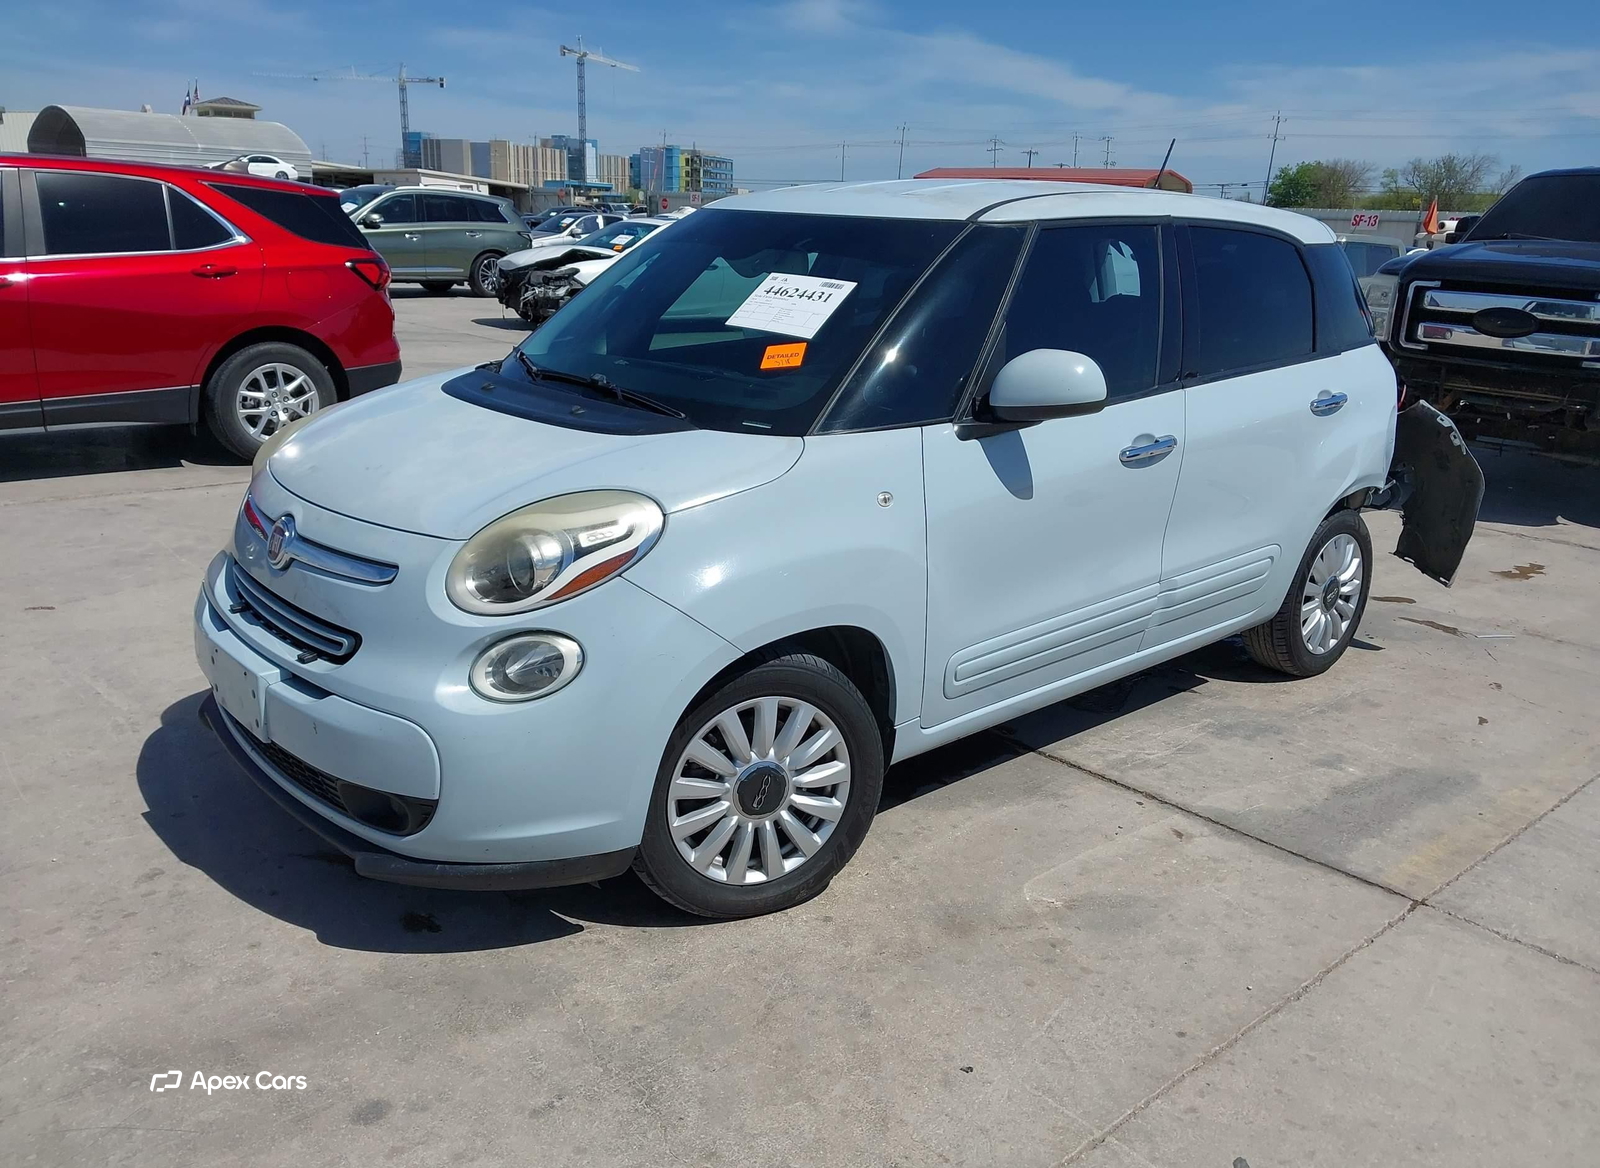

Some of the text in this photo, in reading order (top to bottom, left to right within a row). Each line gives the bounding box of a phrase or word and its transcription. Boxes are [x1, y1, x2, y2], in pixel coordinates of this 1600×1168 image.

[1351, 214, 1379, 227] SF-13
[763, 285, 833, 303] 44624431
[766, 352, 800, 360] DETAILED
